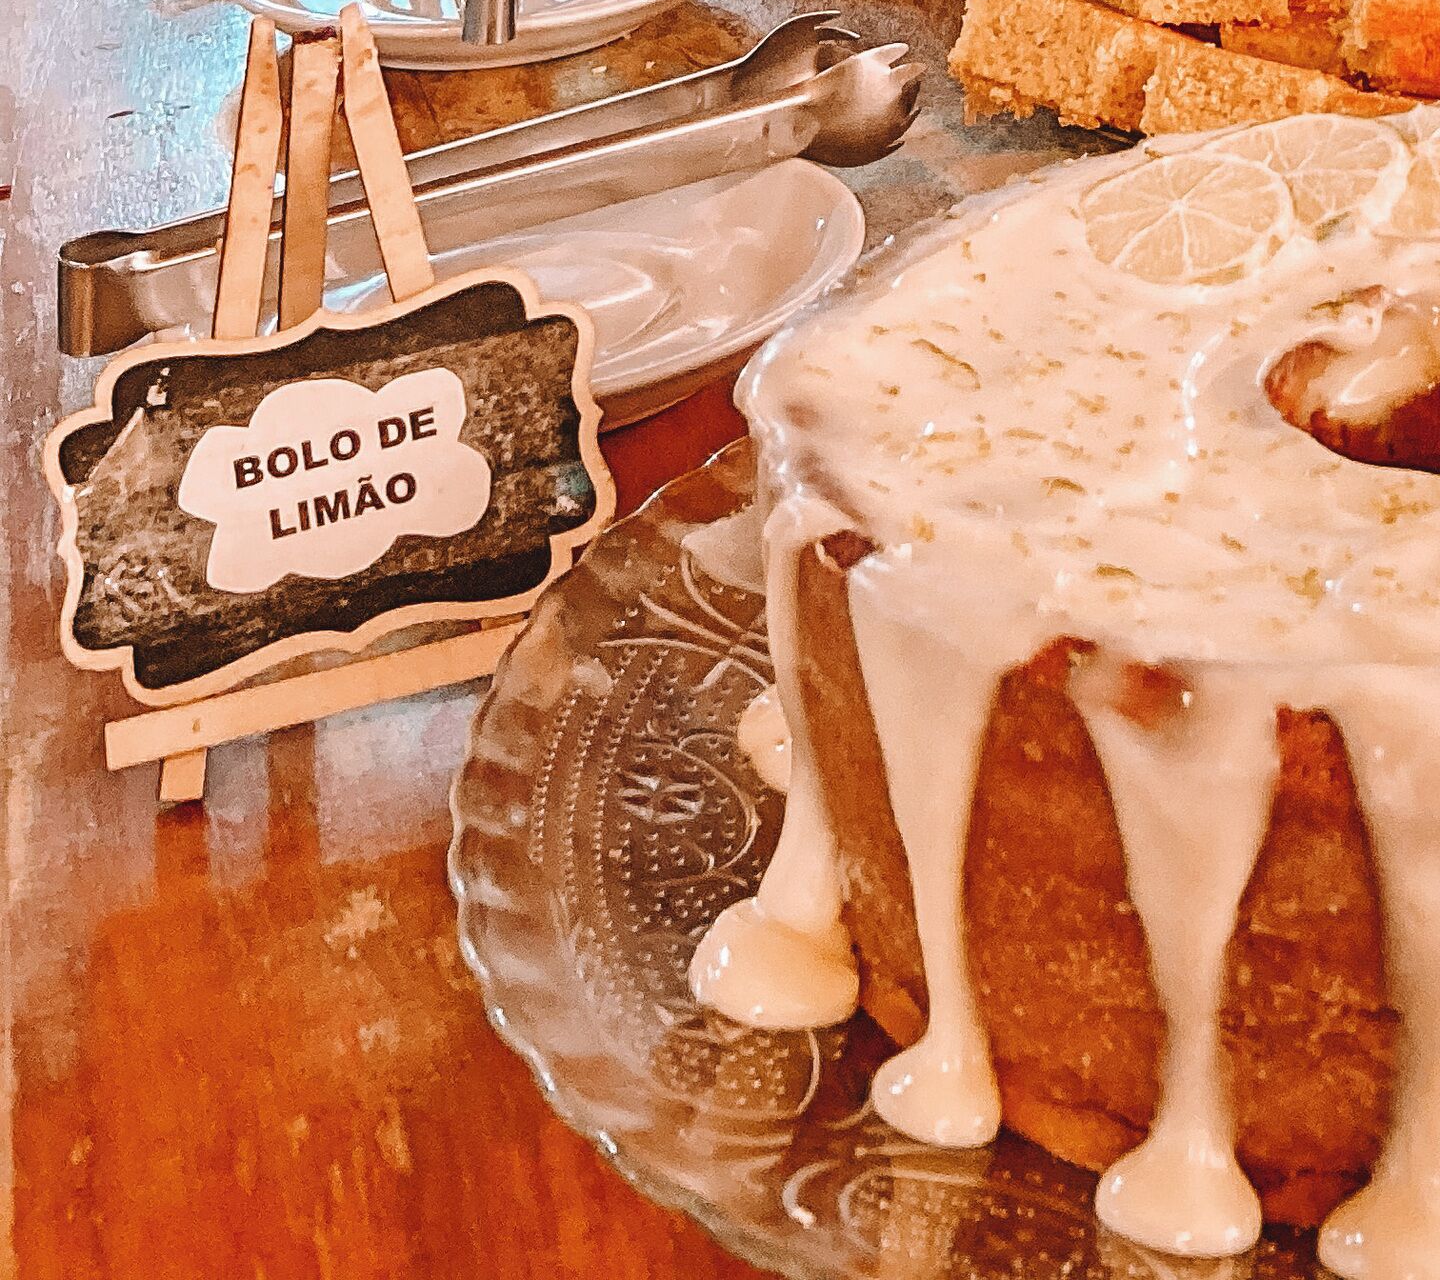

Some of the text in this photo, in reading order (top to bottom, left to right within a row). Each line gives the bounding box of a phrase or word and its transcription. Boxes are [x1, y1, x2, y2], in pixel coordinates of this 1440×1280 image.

[233, 406, 438, 489] BOLO DE
[269, 472, 417, 540] LIMÃO
